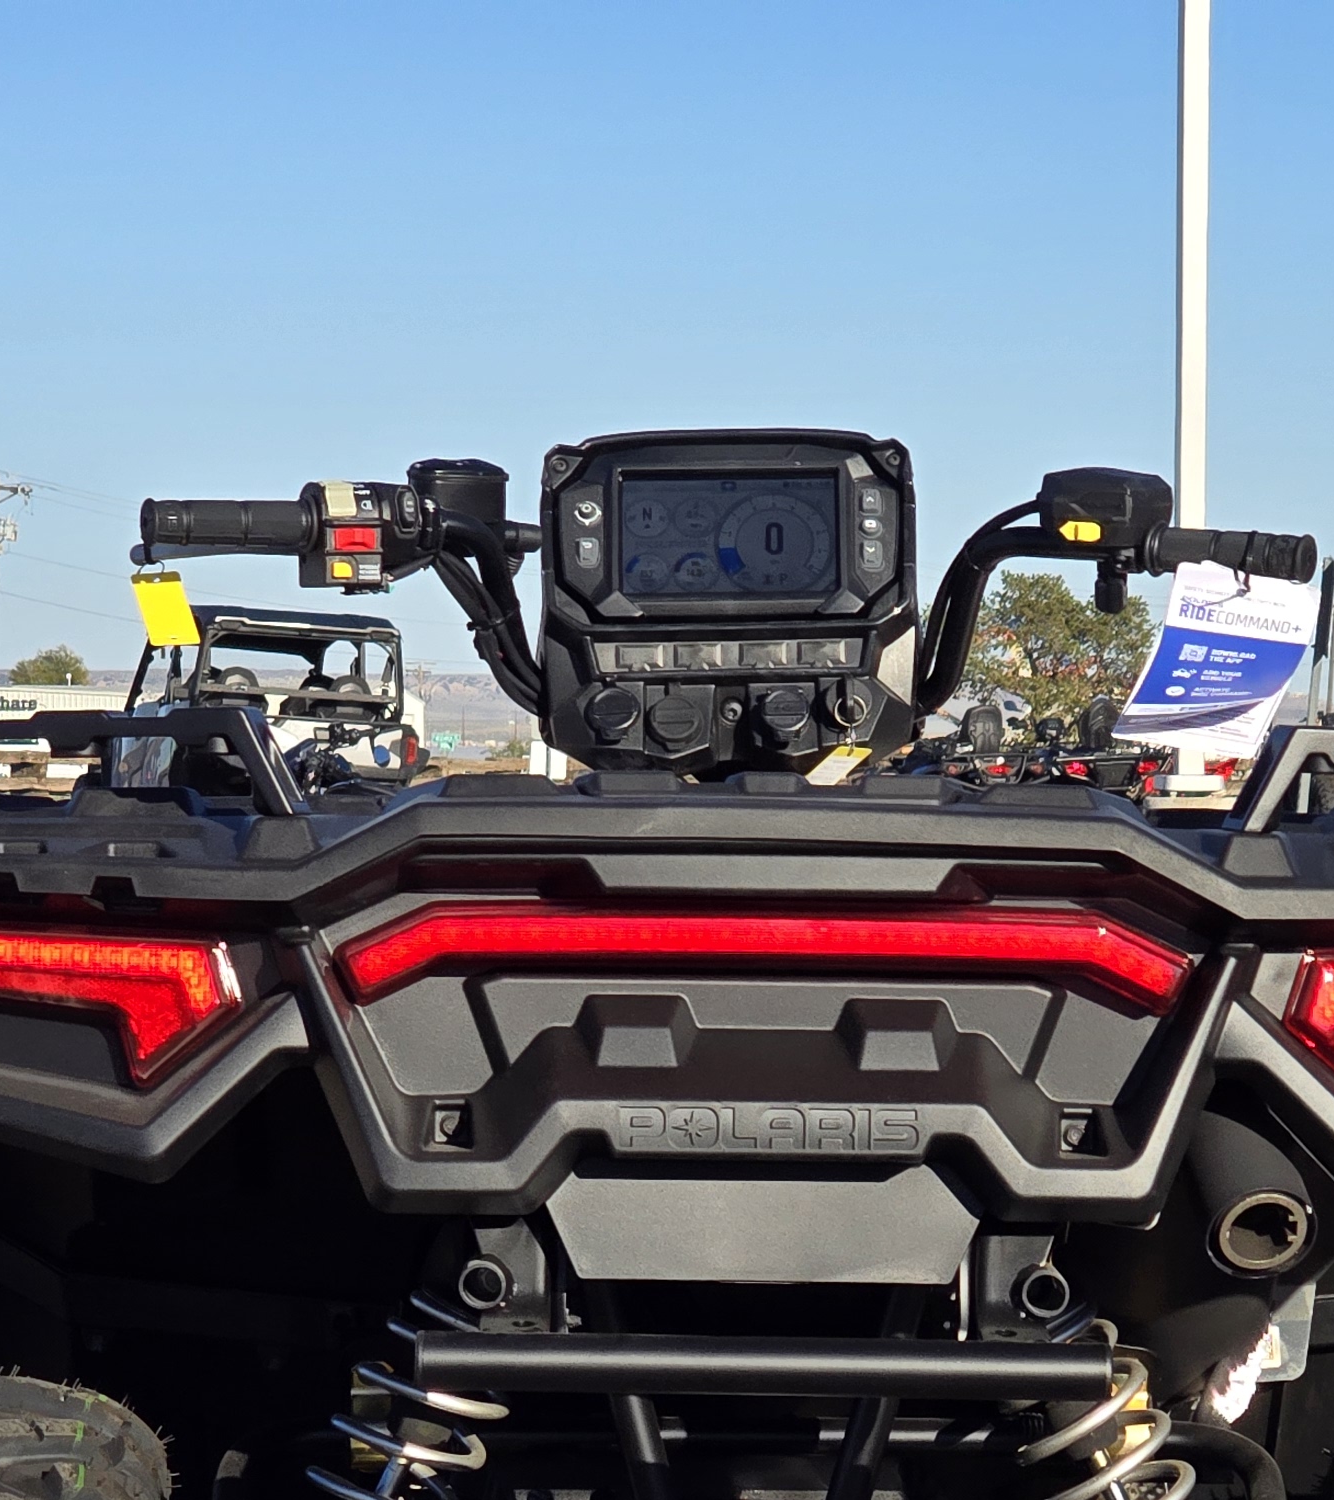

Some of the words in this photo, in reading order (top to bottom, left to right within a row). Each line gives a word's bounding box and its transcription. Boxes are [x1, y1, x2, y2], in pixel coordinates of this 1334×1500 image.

[642, 506, 652, 521] N
[764, 521, 784, 556] 0
[617, 1104, 921, 1152] POLARIS
